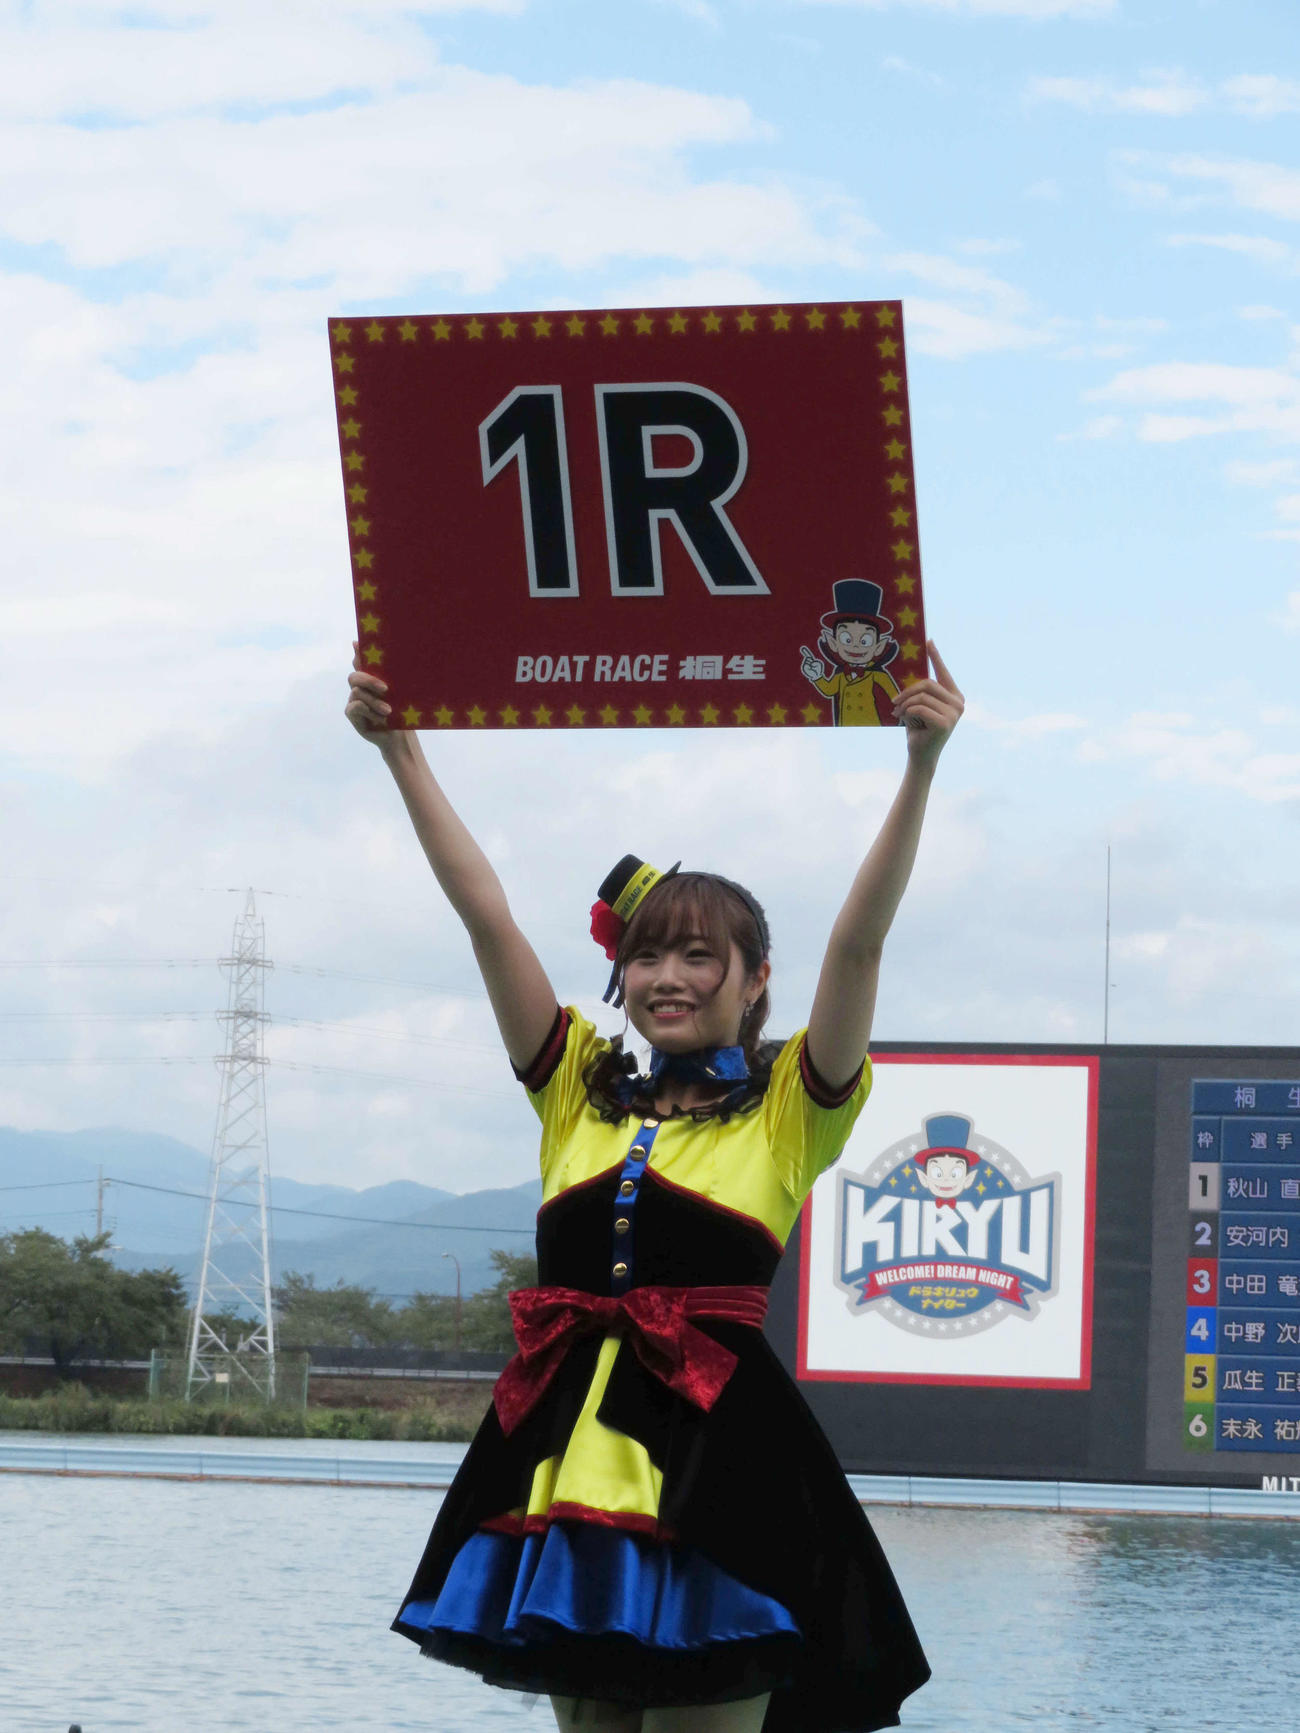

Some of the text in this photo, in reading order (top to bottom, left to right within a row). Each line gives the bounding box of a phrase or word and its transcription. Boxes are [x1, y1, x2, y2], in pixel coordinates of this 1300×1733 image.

[478, 381, 772, 598] 1R
[515, 655, 766, 683] BOAT RACE 桐生
[1197, 1131, 1214, 1149] 枠
[1198, 1175, 1208, 1197] 1
[1227, 1177, 1268, 1198] 秋山
[844, 1183, 1051, 1282] KIRYU
[1194, 1221, 1212, 1246] 2
[1226, 1226, 1289, 1248] 安河内
[874, 1264, 1014, 1289] WELCOME! DREAM NIGHT
[1193, 1269, 1211, 1294] 3
[1225, 1273, 1300, 1296] 中田 竜
[1190, 1318, 1209, 1341] 4
[1224, 1321, 1300, 1344] 中野 次
[1191, 1366, 1209, 1390] 5
[1222, 1370, 1300, 1392] 瓜生 正
[1189, 1414, 1208, 1438] 6
[1262, 1476, 1300, 1491] MIT
